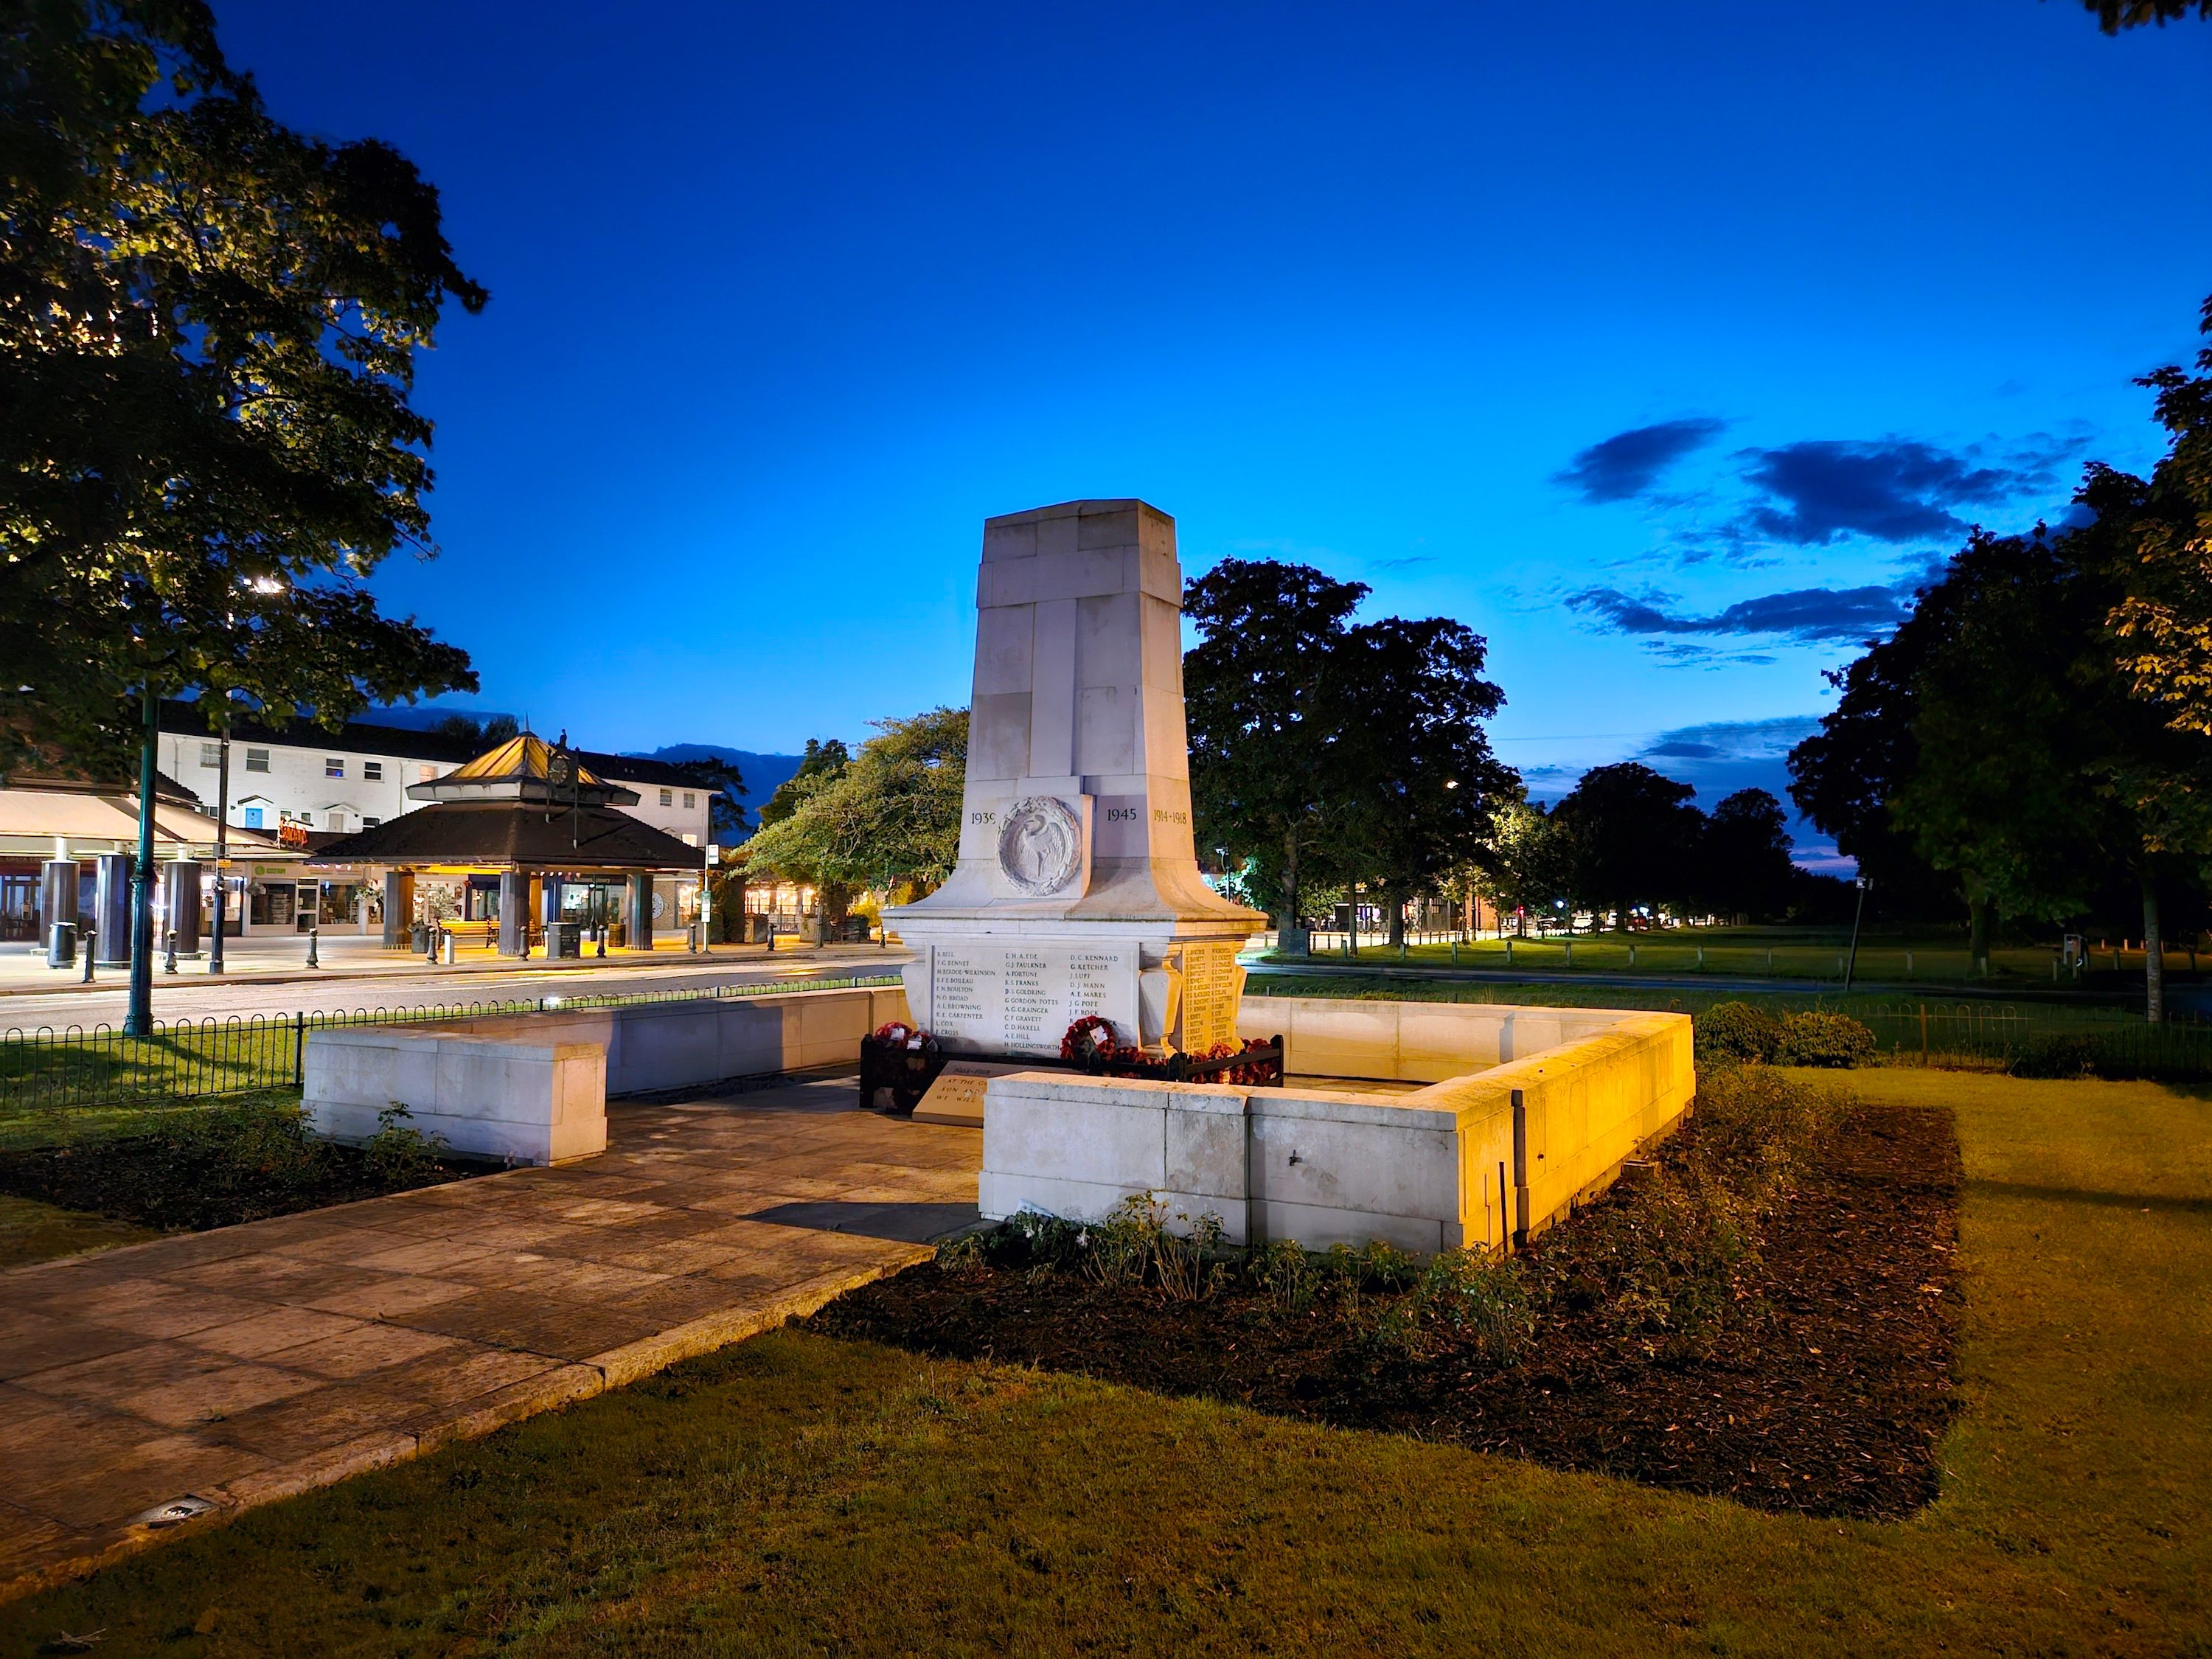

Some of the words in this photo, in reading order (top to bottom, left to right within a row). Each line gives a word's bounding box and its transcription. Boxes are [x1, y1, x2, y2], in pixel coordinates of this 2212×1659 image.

[1107, 809, 1136, 821] 1945
[1154, 810, 1188, 824] 1914-1918
[1011, 1042, 1060, 1051] HOLLINGSWORTH
